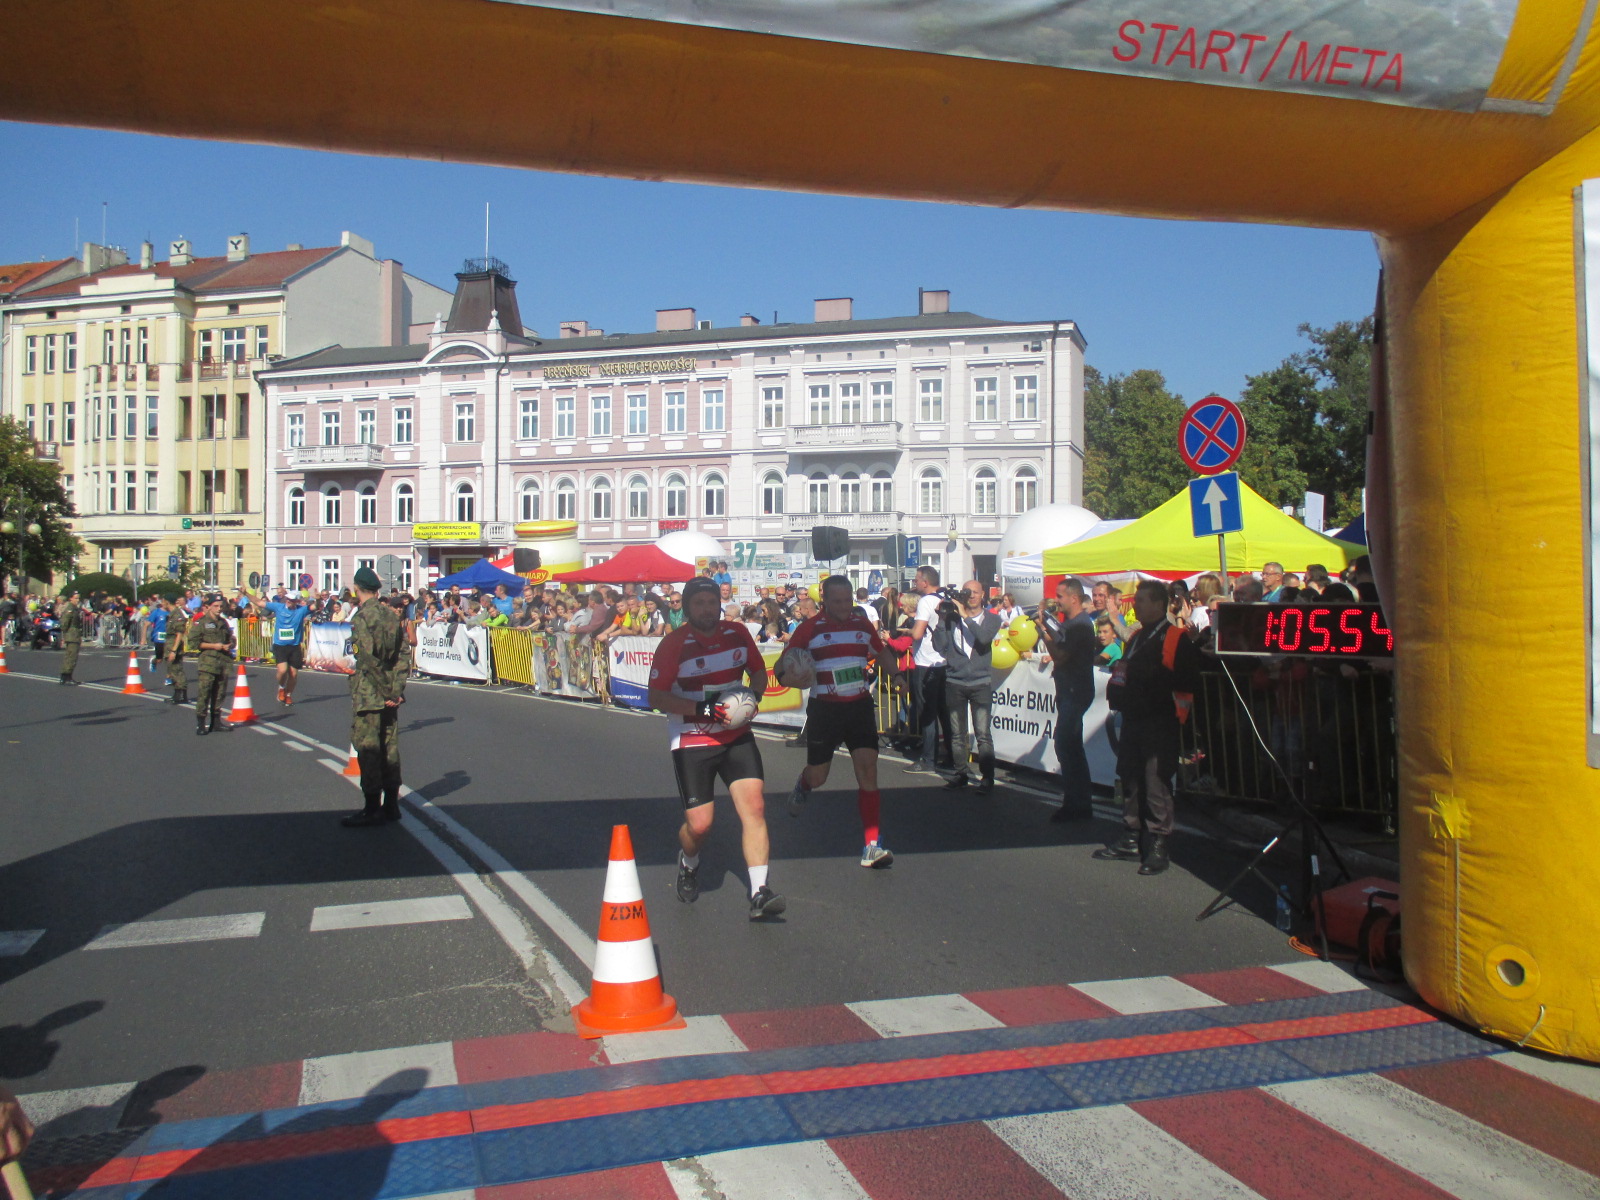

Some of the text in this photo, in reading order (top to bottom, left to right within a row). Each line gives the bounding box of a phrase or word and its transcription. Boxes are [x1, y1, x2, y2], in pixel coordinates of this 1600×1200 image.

[1112, 19, 1404, 92] START/META
[543, 356, 697, 379] BRYŃSKI NIERUCHOMOŚCI
[733, 541, 757, 569] 37
[908, 540, 917, 559] P
[422, 636, 438, 647] Dealer
[421, 648, 462, 661] Premium Arena
[609, 904, 644, 921] ZDM
